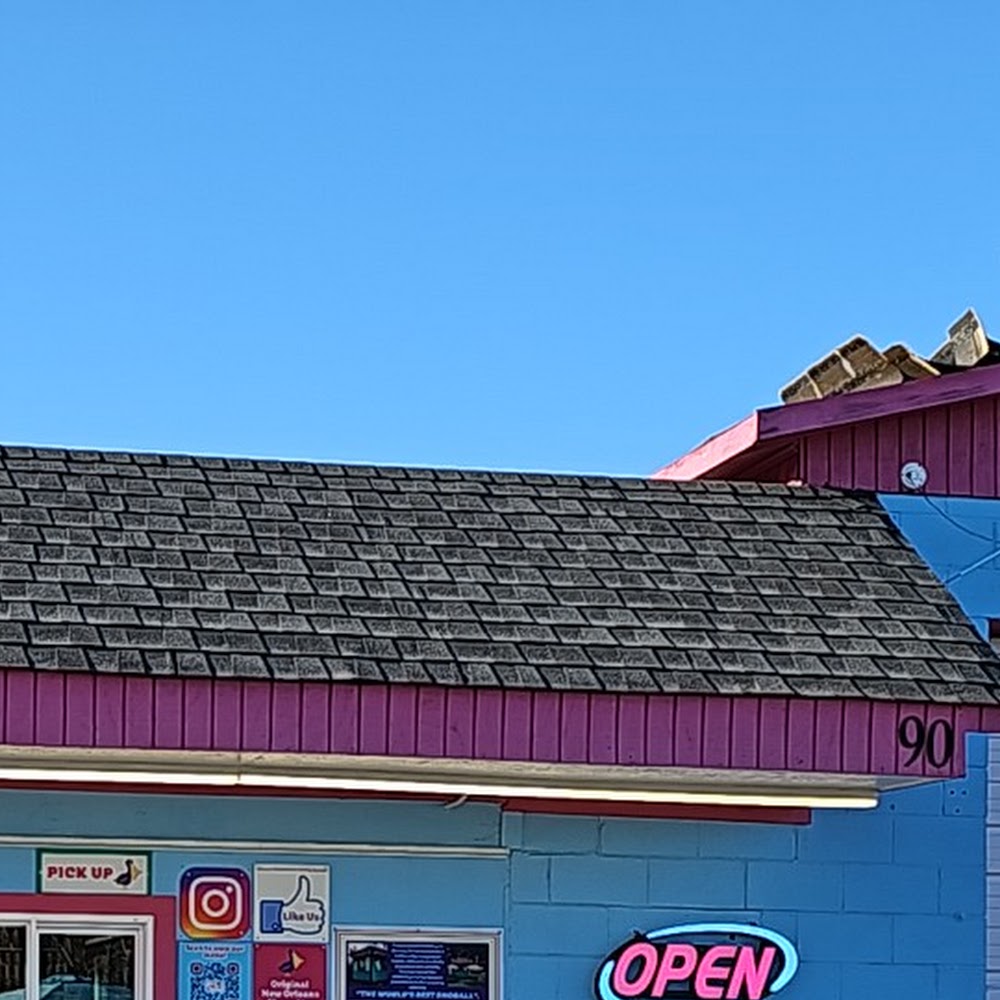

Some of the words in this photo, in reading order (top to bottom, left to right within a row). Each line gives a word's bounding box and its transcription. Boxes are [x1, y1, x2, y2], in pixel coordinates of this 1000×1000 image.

[899, 715, 955, 768] 90
[47, 866, 87, 878] PICK
[91, 866, 114, 879] UP
[283, 910, 304, 922] Like
[306, 911, 320, 922] Us
[614, 942, 776, 1000] OPEN
[270, 980, 309, 990] Original
[261, 990, 282, 998] New
[283, 990, 320, 998] Orleans
